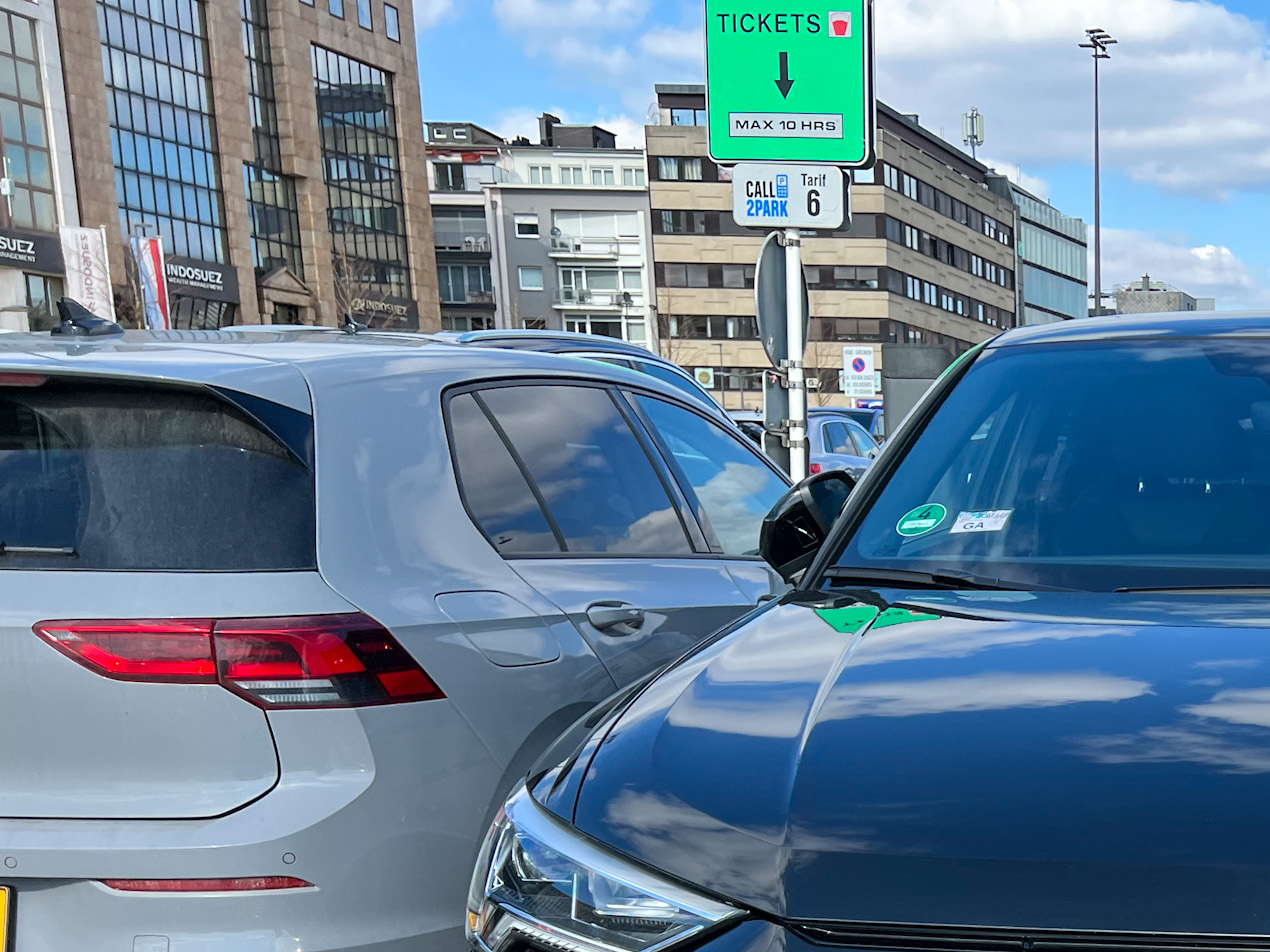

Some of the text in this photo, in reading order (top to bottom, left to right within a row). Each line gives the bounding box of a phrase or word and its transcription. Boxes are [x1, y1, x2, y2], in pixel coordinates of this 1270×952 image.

[717, 13, 821, 34] TICKETS
[735, 119, 836, 131] MAX 10 HRS
[746, 180, 776, 198] CALL
[801, 173, 827, 187] Tarif
[746, 199, 788, 218] 2PARK
[807, 189, 821, 217] 6
[166, 263, 223, 284] INDOSUEZ
[918, 506, 934, 520] 4
[963, 521, 983, 531] GA
